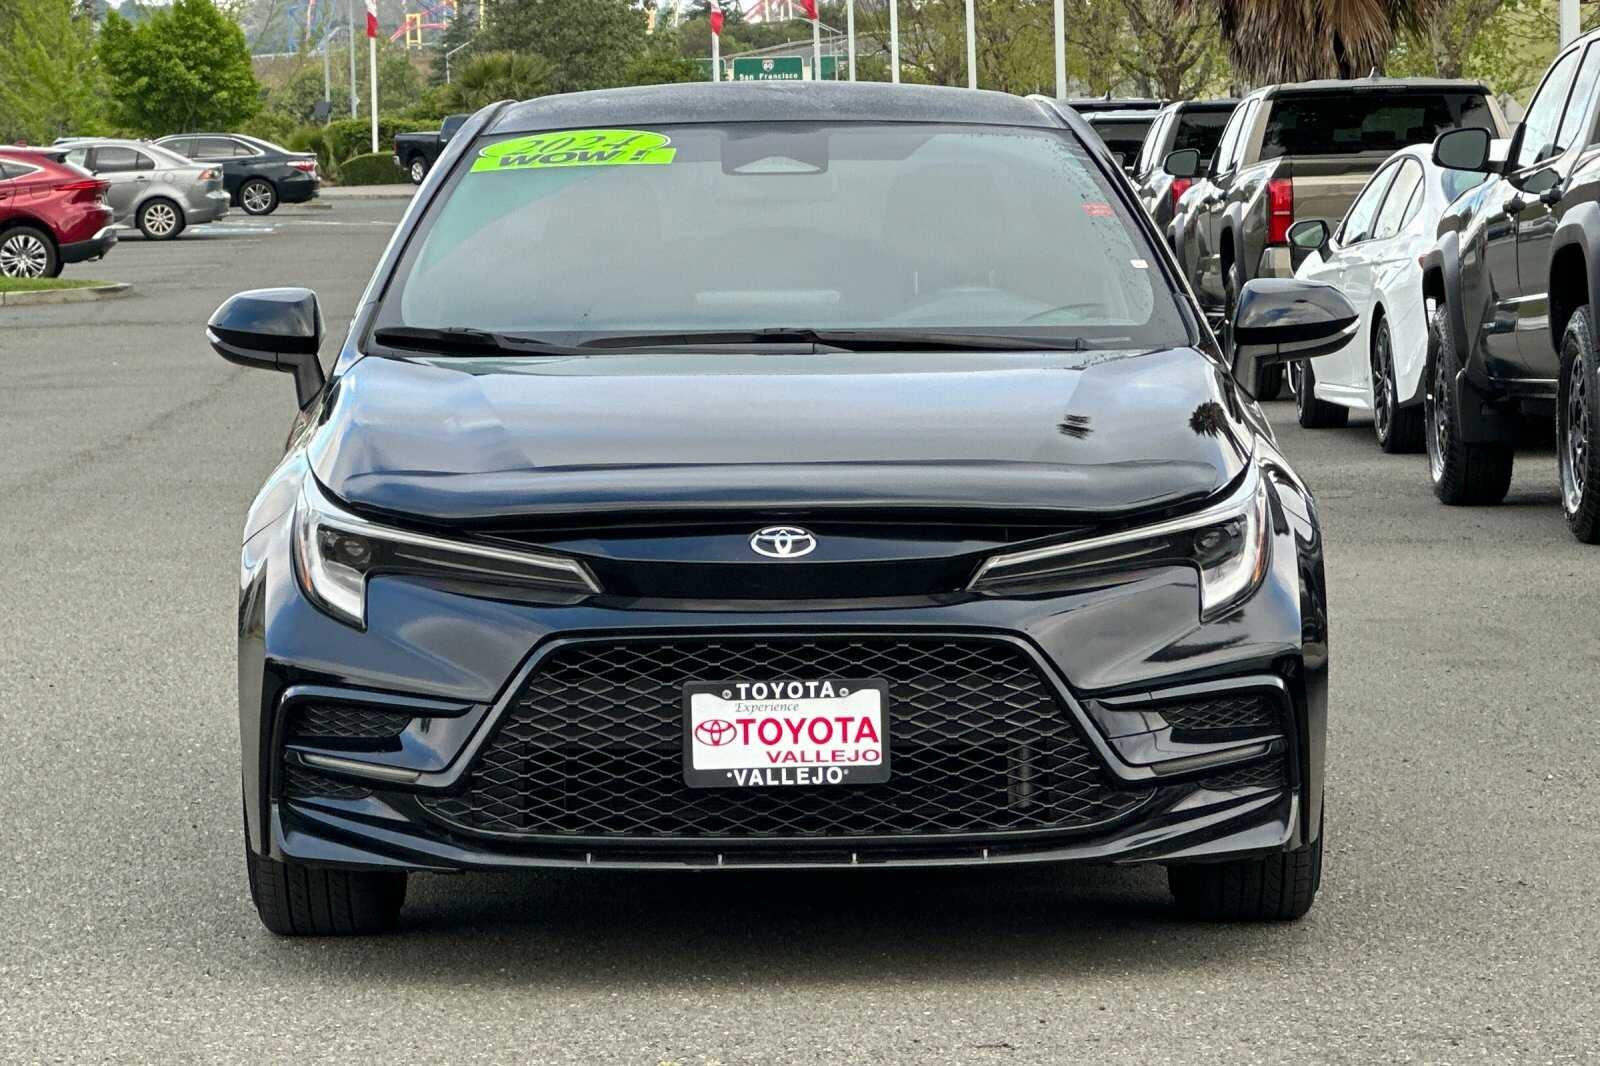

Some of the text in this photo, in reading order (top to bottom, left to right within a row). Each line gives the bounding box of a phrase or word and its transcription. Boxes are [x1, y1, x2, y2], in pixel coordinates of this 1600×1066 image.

[739, 72, 799, 81] San Francisco
[502, 134, 644, 155] 2024
[736, 681, 835, 700] TOYOTA
[735, 702, 800, 715] Experience
[736, 716, 879, 746] TOYOTA
[766, 749, 880, 763] VALLEJO
[733, 767, 843, 786] VALLEJO
